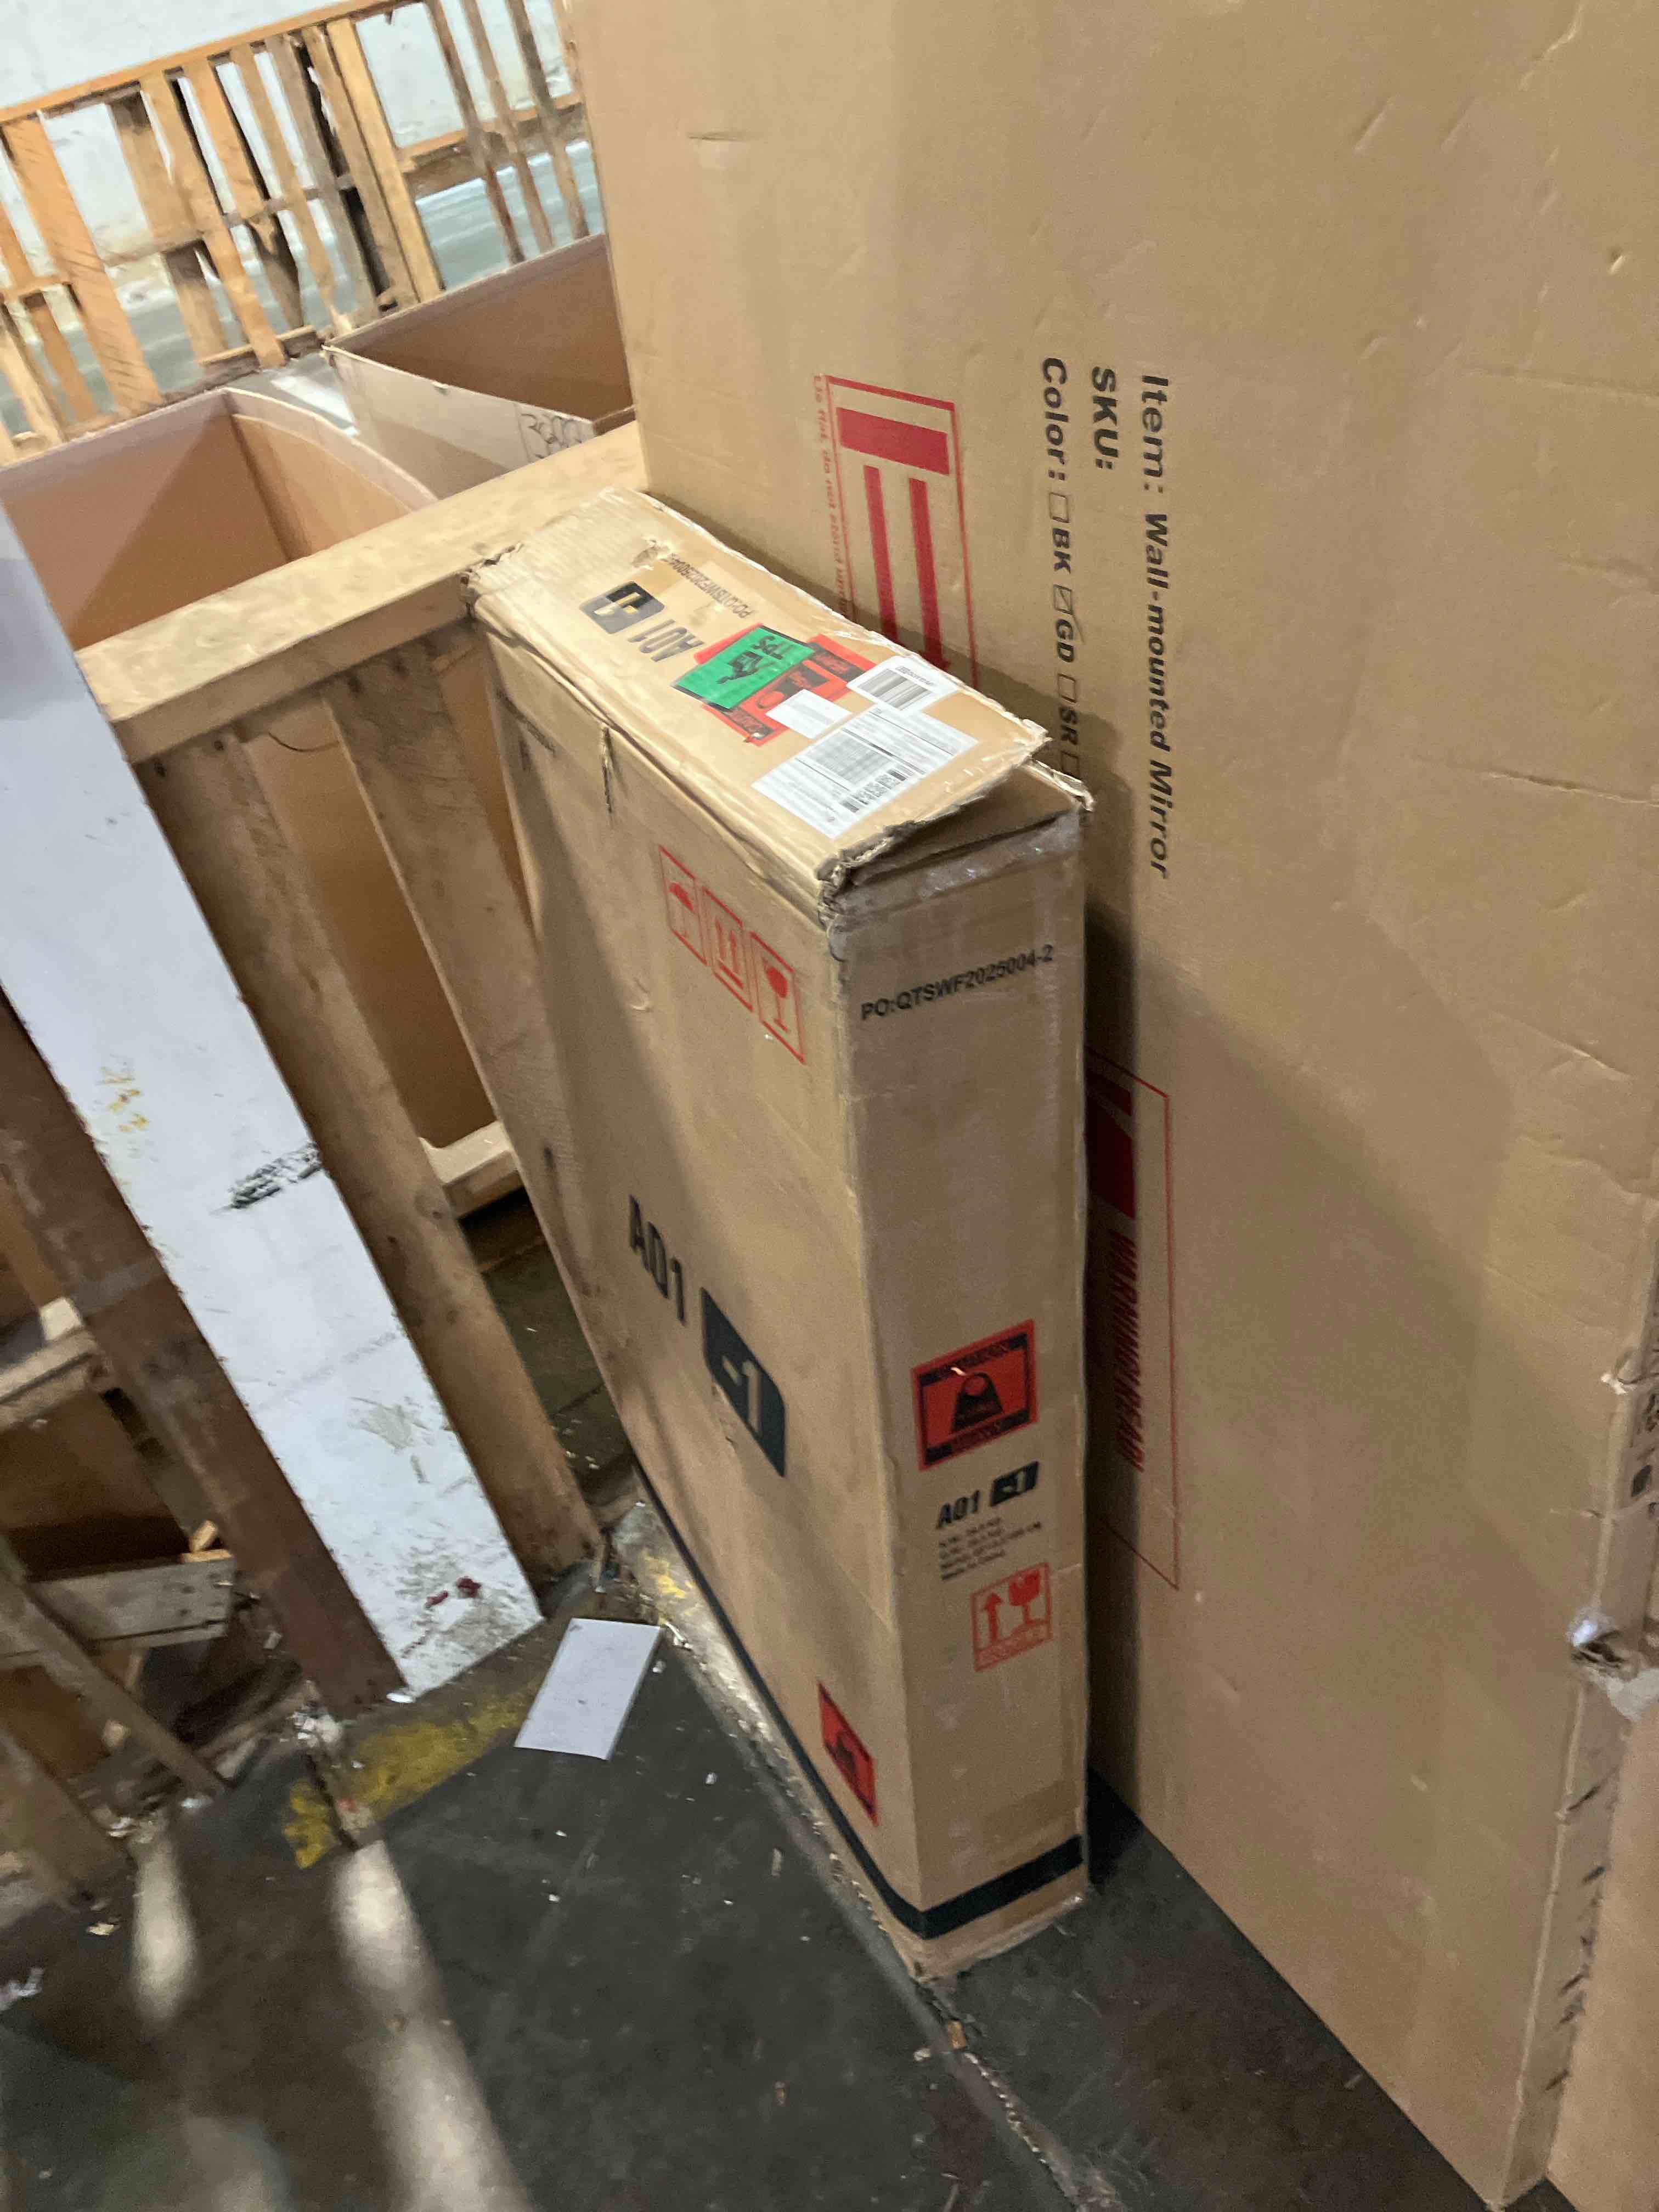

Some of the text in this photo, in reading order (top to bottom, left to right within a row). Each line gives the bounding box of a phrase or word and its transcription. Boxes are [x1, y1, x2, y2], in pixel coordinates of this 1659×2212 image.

[1092, 366, 1119, 470] SKU:
[1043, 358, 1078, 746] Color: BK GD SR
[627, 618, 705, 662] A01
[1142, 375, 1173, 879] Item: Wall-mounted Mirror
[629, 1194, 686, 1327] A01
[936, 1489, 980, 1530] A01
